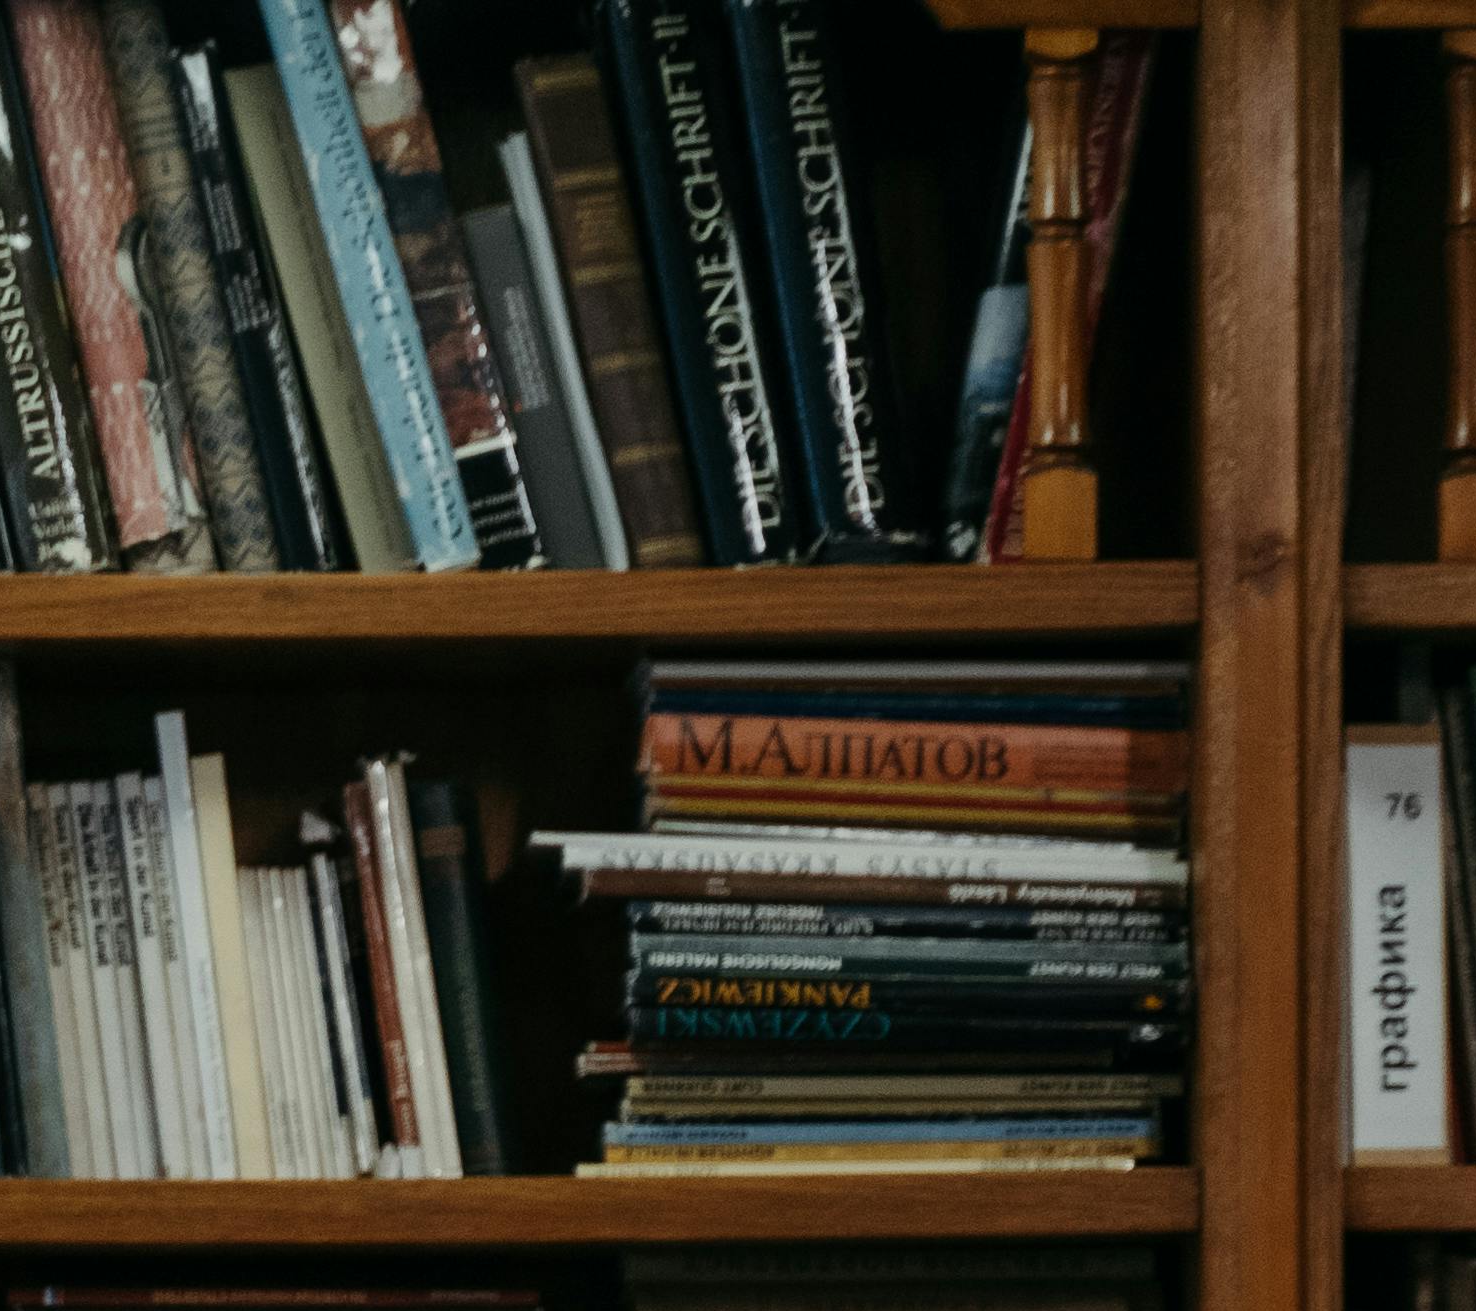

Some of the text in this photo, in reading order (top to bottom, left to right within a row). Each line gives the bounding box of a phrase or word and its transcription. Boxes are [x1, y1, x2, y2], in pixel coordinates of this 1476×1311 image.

[654, 53, 732, 245] SCHRIFT
[773, 19, 844, 215] SCHRIFT
[692, 249, 772, 453] SCHÖNE
[867, 851, 1002, 877] STASYS
[1384, 792, 1424, 821] 76
[659, 977, 872, 1010] PANKIEWICZ
[1371, 883, 1418, 1094] графика
